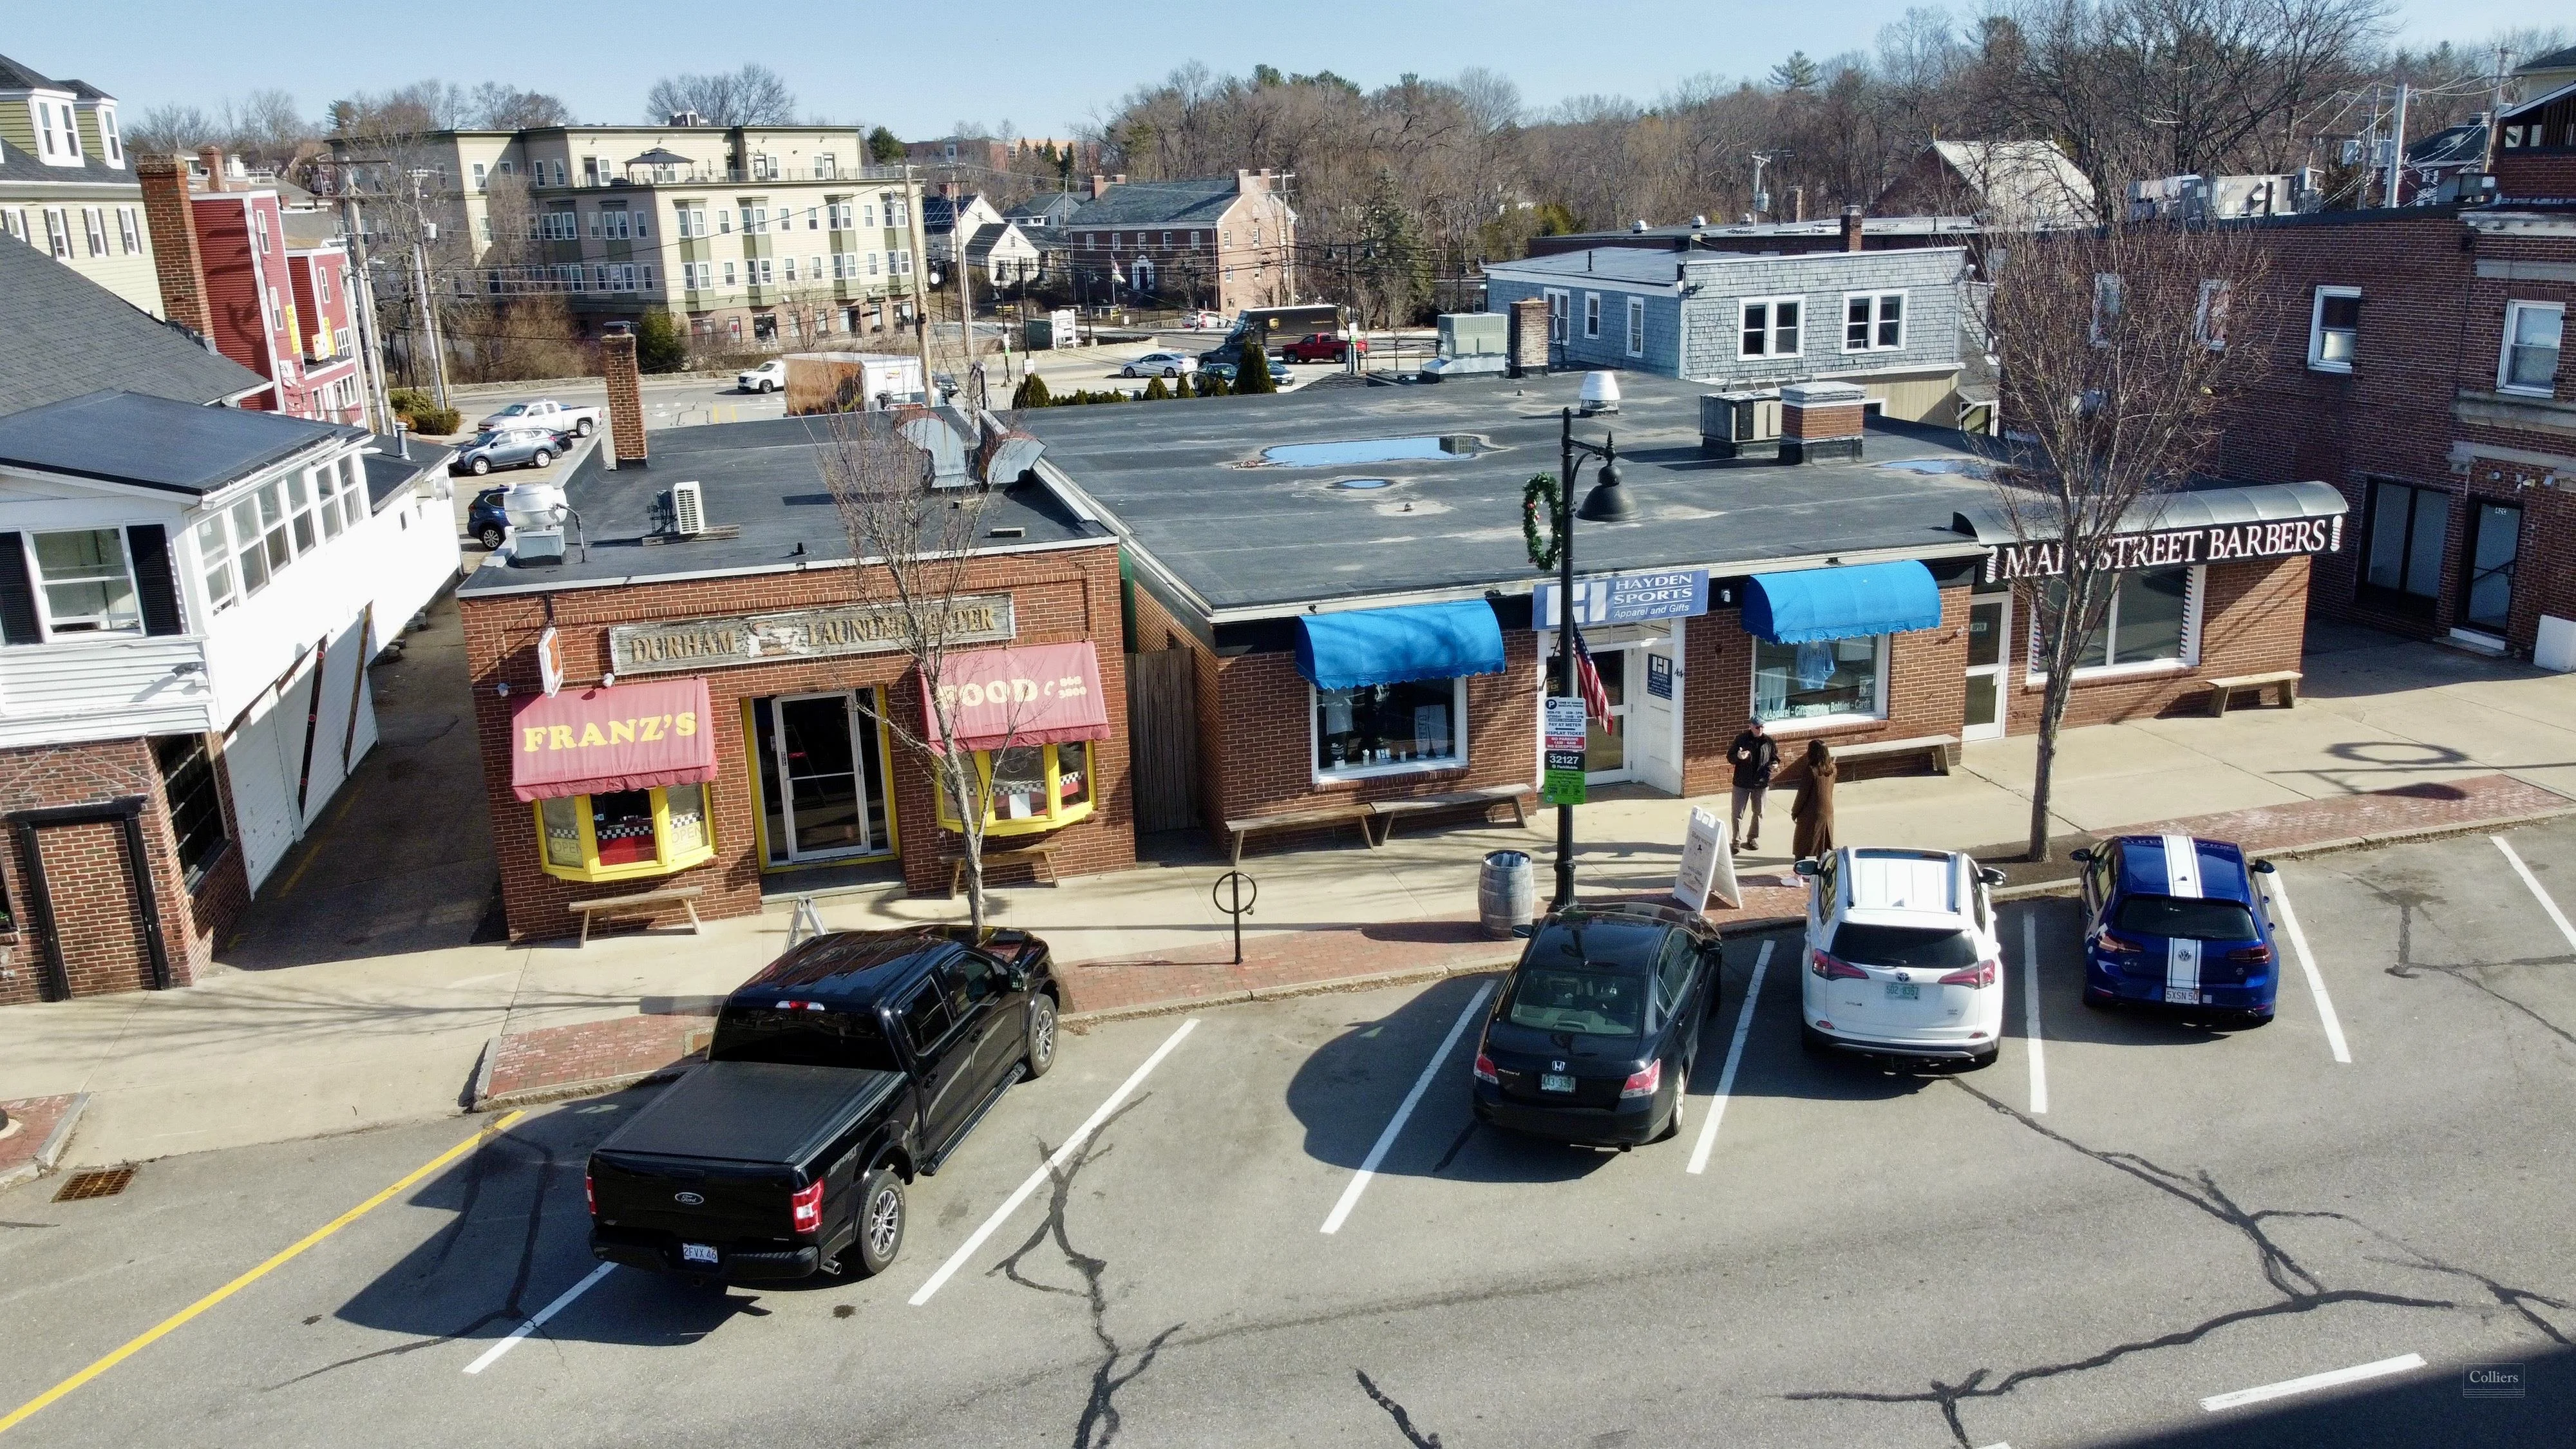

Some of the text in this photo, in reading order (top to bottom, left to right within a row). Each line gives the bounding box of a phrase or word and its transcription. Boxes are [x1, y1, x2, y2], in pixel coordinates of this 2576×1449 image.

[2208, 519, 2326, 560] BARBERS
[1615, 573, 1692, 591] HAYDEN
[1613, 587, 1692, 605] SPORTS
[1613, 603, 1690, 619] Apparel and Gifts
[631, 630, 739, 663] DURHAM
[936, 679, 1038, 710] FOOD
[1768, 706, 1790, 721] Apparel
[1830, 701, 1850, 712] Bottles
[1854, 699, 1871, 709] Cards
[522, 712, 697, 753] FRANZ'S
[1549, 755, 1579, 764] 32127
[671, 827, 702, 844] OPEN
